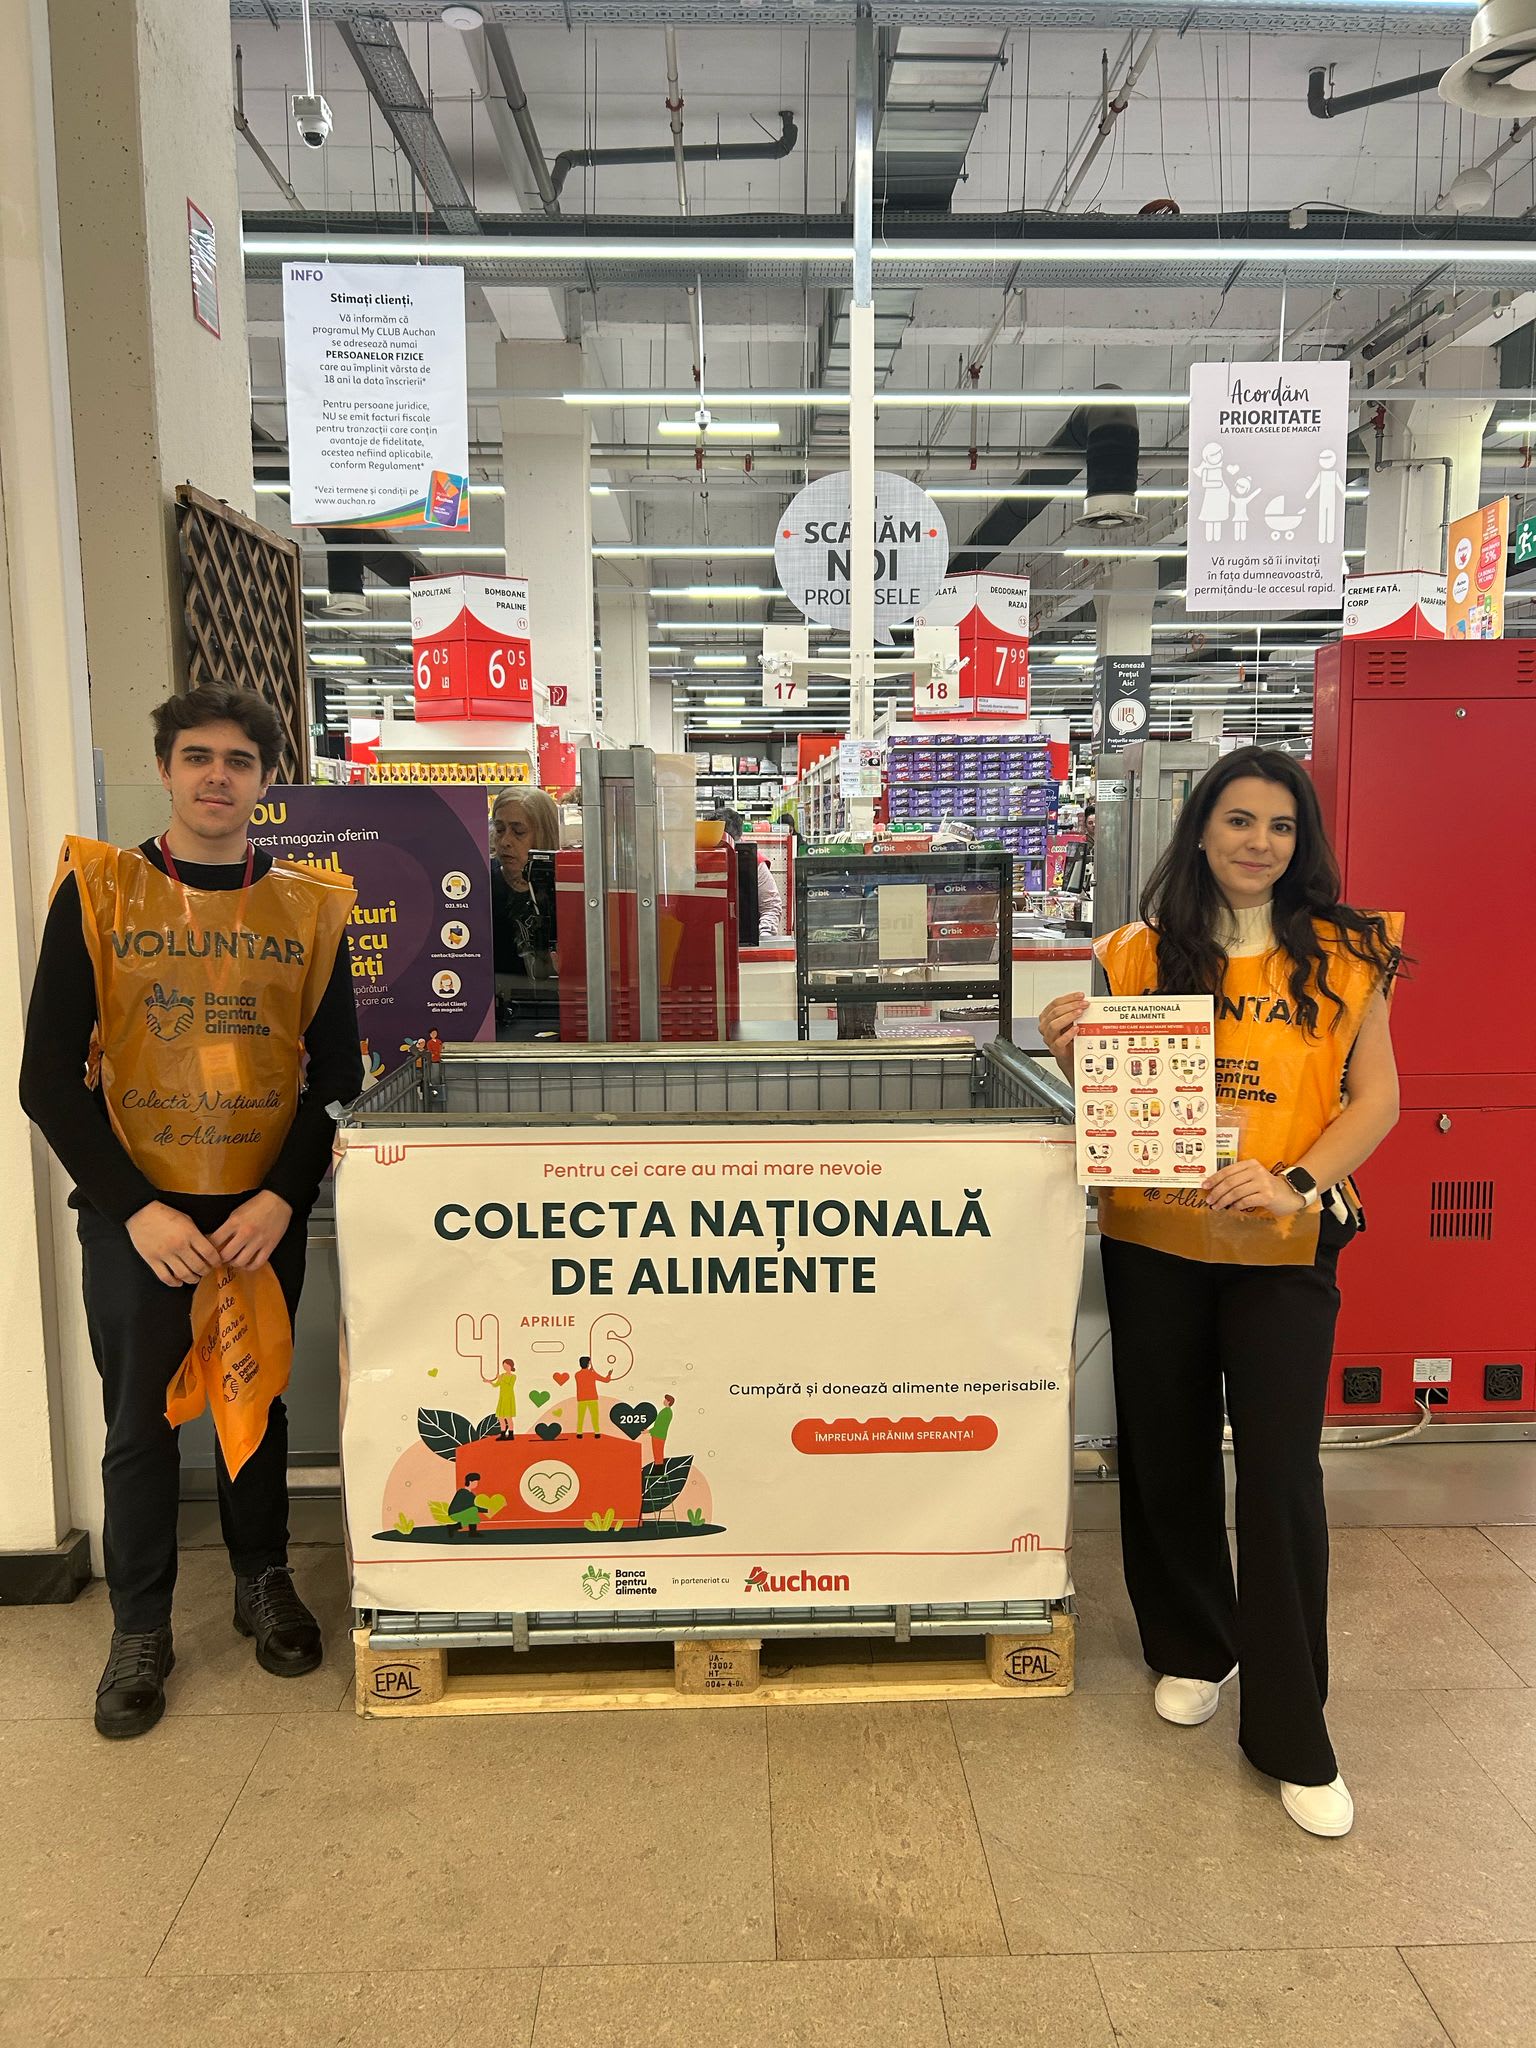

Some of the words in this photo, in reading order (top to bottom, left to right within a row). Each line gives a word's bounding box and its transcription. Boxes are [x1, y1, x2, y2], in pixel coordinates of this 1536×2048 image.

[290, 269, 323, 281] INFO
[330, 293, 372, 307] Stimați
[375, 294, 414, 307] clienți,
[339, 313, 351, 322] Vă
[353, 314, 397, 324] informăm
[398, 315, 409, 324] că
[312, 326, 359, 335] programul
[361, 327, 375, 337] My
[376, 327, 401, 336] CLUB
[402, 328, 436, 336] Auchan
[331, 339, 342, 347] se
[343, 338, 388, 348] adresează
[390, 340, 418, 349] numai
[326, 350, 394, 360] PERSOANELOR
[396, 352, 424, 361] FIZICE
[324, 375, 335, 384] 18
[336, 375, 351, 384] ani
[352, 376, 361, 384] la
[363, 376, 384, 385] data
[1230, 376, 1310, 406] Acordăm
[323, 400, 351, 409] Pentru
[353, 401, 394, 411] persoane
[395, 402, 430, 411] juridice,
[322, 412, 336, 421] NU
[338, 413, 348, 421] se
[350, 413, 370, 421] emit
[371, 413, 401, 422] facturi
[402, 413, 431, 422] fiscale
[1219, 409, 1322, 426] PRIORITATE
[315, 425, 345, 434] pentru
[1220, 426, 1231, 434] LA
[1231, 426, 1254, 434] TOATE
[1254, 426, 1281, 434] CASELE
[1292, 425, 1321, 433] MARCAT
[329, 437, 368, 446] avantaje
[382, 438, 424, 447] fidelitate,
[321, 449, 354, 457] acestea
[356, 449, 387, 458] nefiind
[388, 450, 433, 460] aplicabile,
[330, 461, 366, 470] conform
[315, 497, 376, 505] www.auchan.ro
[804, 515, 920, 544] SCAĂM
[1211, 556, 1225, 566] Vă
[1227, 556, 1260, 568] rugăm
[1262, 556, 1274, 566] să
[1275, 555, 1283, 565] îi
[1284, 555, 1321, 566] invitați
[1207, 570, 1217, 580] în
[1219, 569, 1241, 581] fața
[1242, 569, 1323, 580] dumneavoastră,
[412, 587, 452, 598] NAPOLITANE
[484, 588, 526, 599] BOMBOANE
[935, 586, 957, 596] LATĂ
[990, 586, 1027, 596] DEODORANT
[1194, 584, 1266, 597] permițându-le
[1268, 584, 1305, 594] accesul
[1307, 583, 1336, 595] rapid.
[1348, 586, 1374, 595] CREME
[496, 601, 526, 611] PRALINE
[1347, 599, 1369, 607] CORP
[417, 650, 431, 690] 6
[488, 650, 505, 689] 6
[996, 647, 1008, 686] 7
[1118, 671, 1139, 679] Prețul
[441, 677, 450, 689] LEI
[519, 679, 529, 690] LEI
[774, 683, 797, 700] 17
[926, 682, 948, 700] 18
[249, 802, 287, 825] OU
[281, 830, 334, 847] magazin
[337, 828, 379, 842] oferim
[807, 847, 830, 856] Orbit
[873, 843, 896, 853] Orbit
[807, 889, 829, 898] Orbit
[944, 885, 967, 893] Orbit
[346, 900, 397, 925] turi
[940, 927, 963, 935] Orbit
[359, 933, 388, 950] cu
[112, 930, 305, 966] VOLUNTAR
[350, 953, 384, 984] ăți
[204, 992, 257, 1006] Banca
[1137, 1003, 1181, 1013] NAȚIONALĂ
[205, 1007, 257, 1022] pentru
[1130, 1012, 1166, 1020] ALIMENTE
[205, 1020, 271, 1036] alimente
[1215, 1057, 1259, 1071] anca
[1215, 1071, 1260, 1086] entru
[122, 1089, 190, 1111] Colectă
[190, 1089, 281, 1118] Națională
[153, 1124, 174, 1146] de
[178, 1125, 262, 1146] Alimente
[543, 1161, 606, 1178] Pentru
[610, 1161, 638, 1178] cei
[643, 1163, 687, 1177] care
[691, 1163, 716, 1177] au
[721, 1160, 759, 1176] mai
[763, 1161, 815, 1176] mare
[819, 1159, 882, 1176] nevoie
[433, 1200, 676, 1241] COLECTA
[691, 1187, 992, 1253] NAȚIONALĂ
[552, 1258, 613, 1296] DE
[627, 1256, 877, 1295] ALIMENTE
[520, 1315, 576, 1328] APRILIE
[455, 1313, 499, 1382] 4
[589, 1312, 634, 1381] 6
[729, 1383, 802, 1399] Cumpără
[806, 1382, 818, 1398] și
[822, 1382, 888, 1396] donează
[892, 1382, 959, 1395] alimente
[963, 1379, 1060, 1395] neperisabile.
[619, 1414, 647, 1424] 2025
[814, 1430, 870, 1443] ÎMPREUNĂ
[872, 1429, 914, 1441] HRĂNIM
[916, 1429, 975, 1442] SPERANȚA!
[615, 1569, 646, 1579] Banca
[744, 1566, 850, 1593] Auchan
[615, 1577, 648, 1589] pentru
[671, 1577, 681, 1585] în
[682, 1576, 719, 1586] parteneriat
[615, 1585, 658, 1596] alimente
[708, 1654, 724, 1662] UA-
[1012, 1655, 1054, 1675] EPAL
[374, 1670, 422, 1693] EPAL
